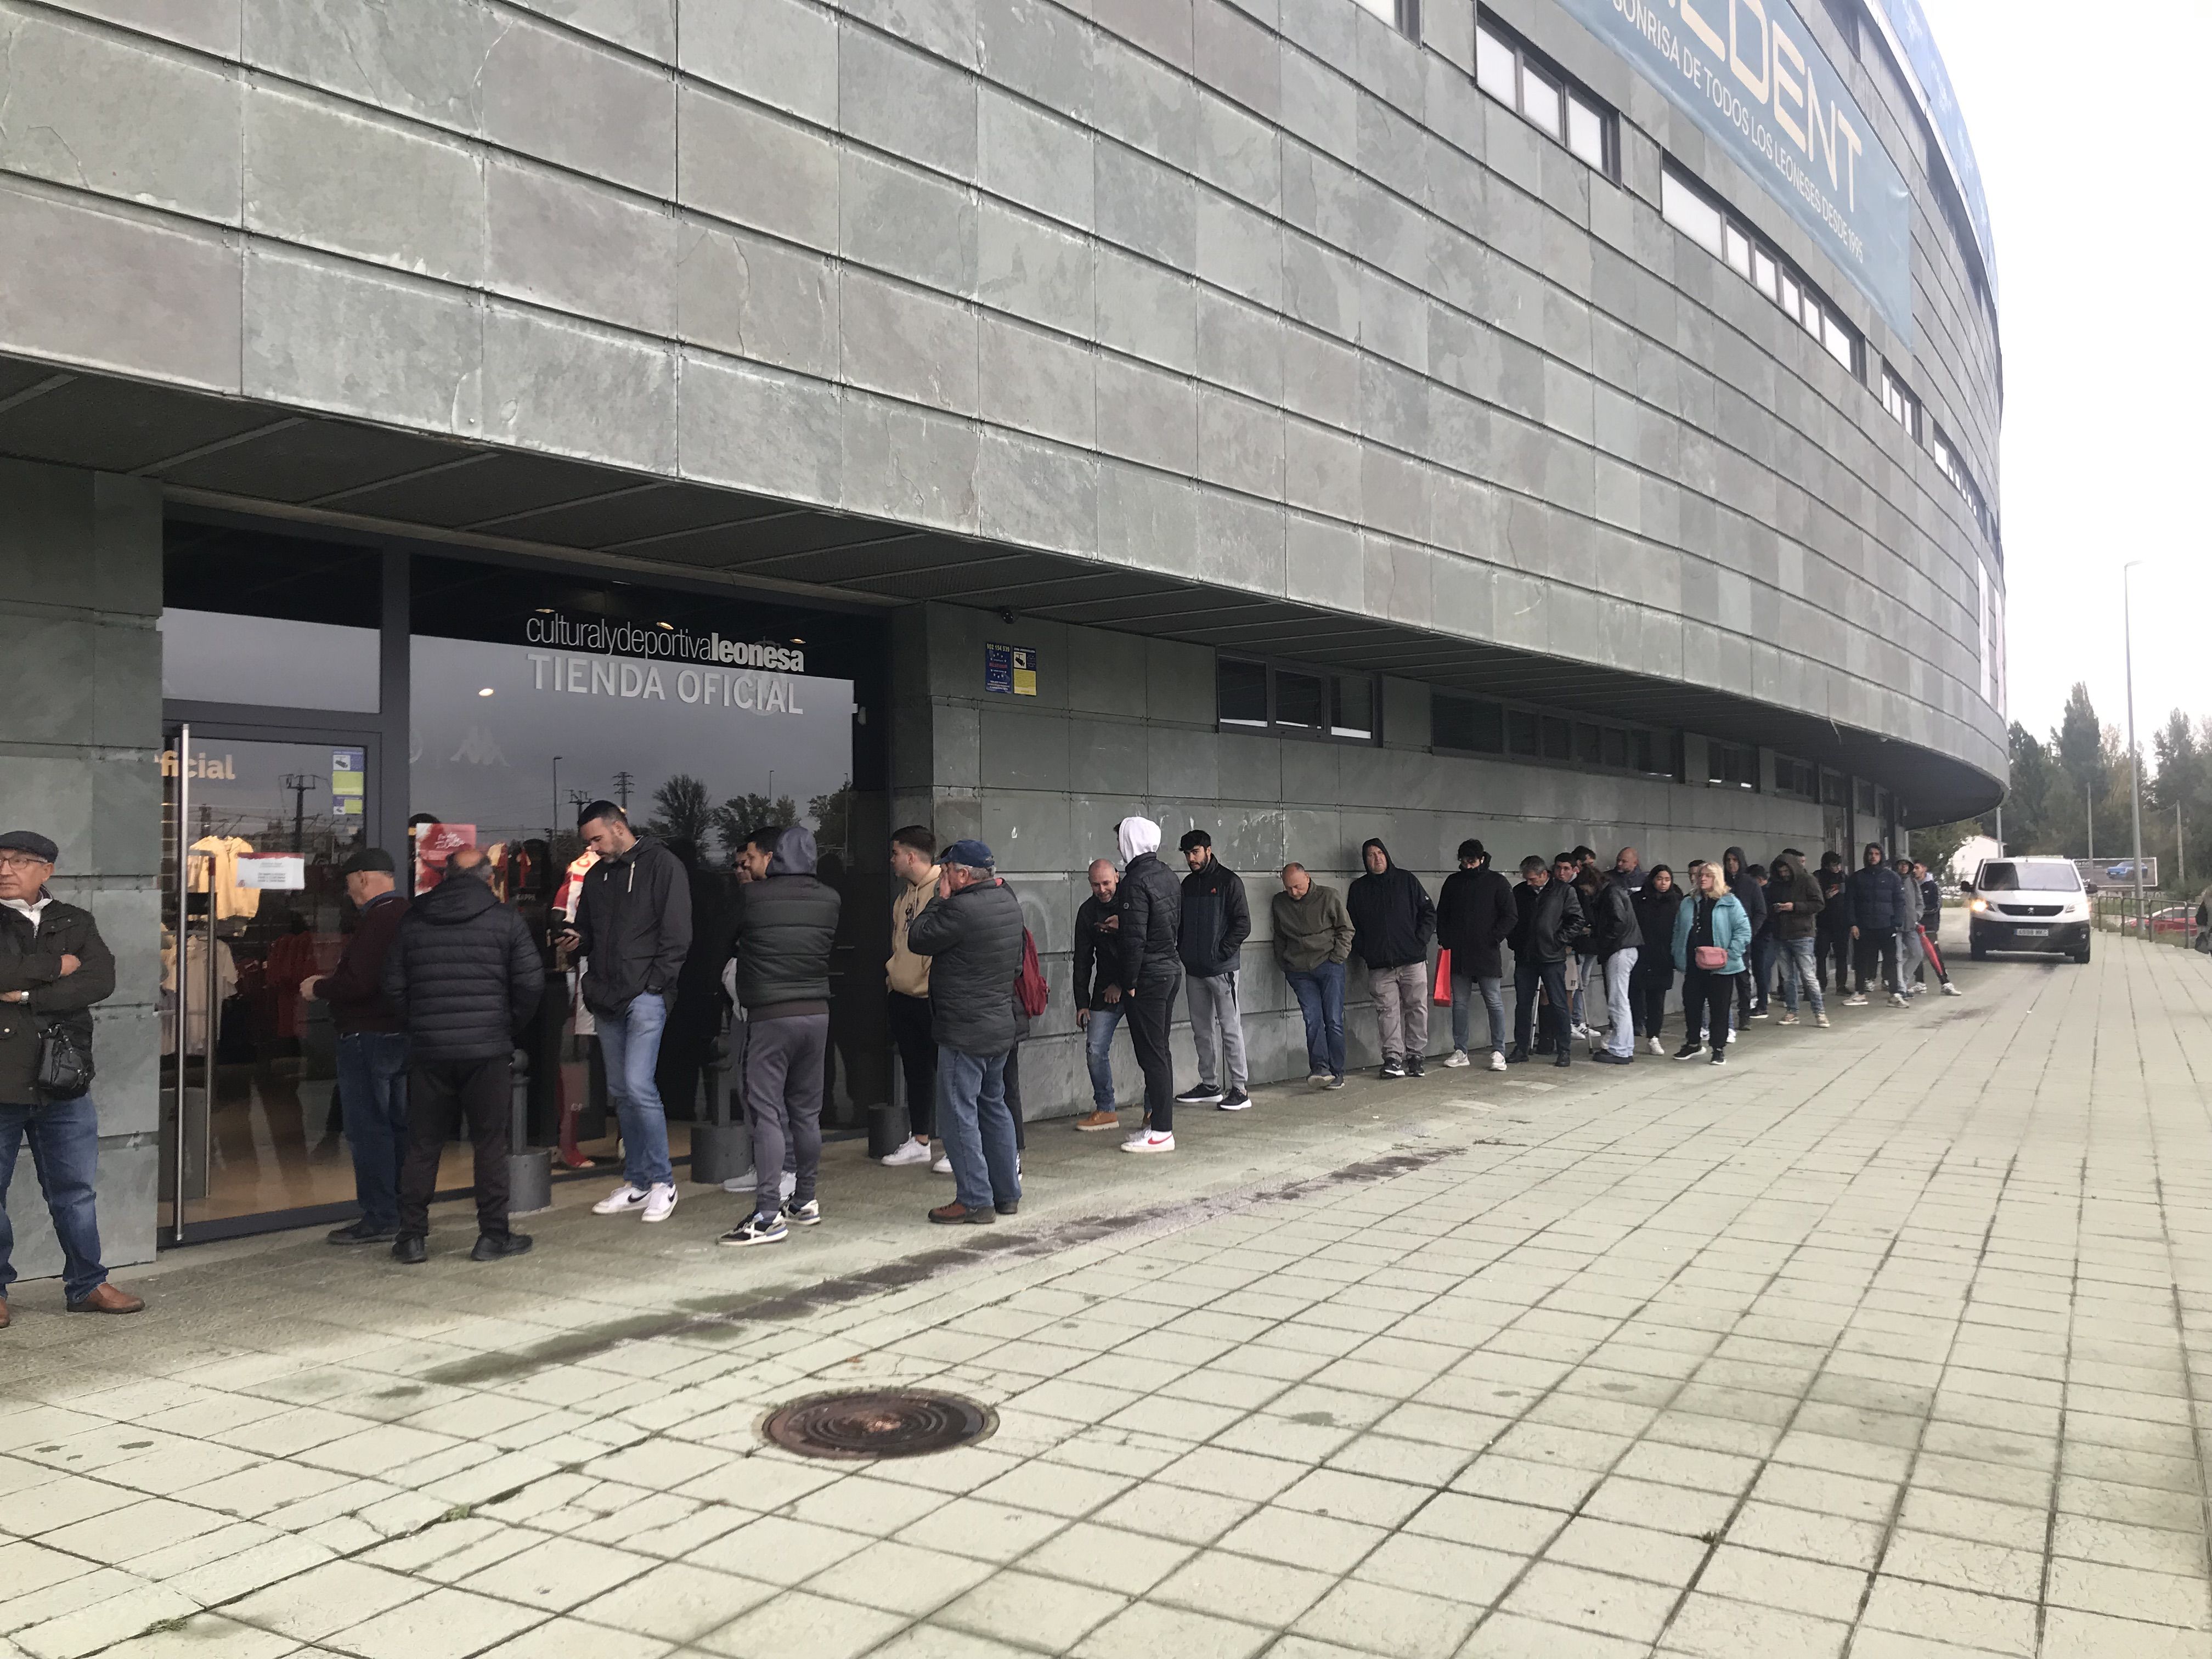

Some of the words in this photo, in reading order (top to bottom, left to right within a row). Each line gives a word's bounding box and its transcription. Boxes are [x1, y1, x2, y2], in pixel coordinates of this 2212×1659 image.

[1683, 46, 1701, 89] DE
[1703, 66, 1750, 136] TODOS
[1751, 115, 1773, 160] LOS
[1774, 140, 1821, 213] LEONESES
[1821, 195, 1848, 246] DESDE
[1848, 228, 1863, 264] 1995
[527, 653, 666, 700] TIENDA
[676, 669, 804, 715] OFICIAL
